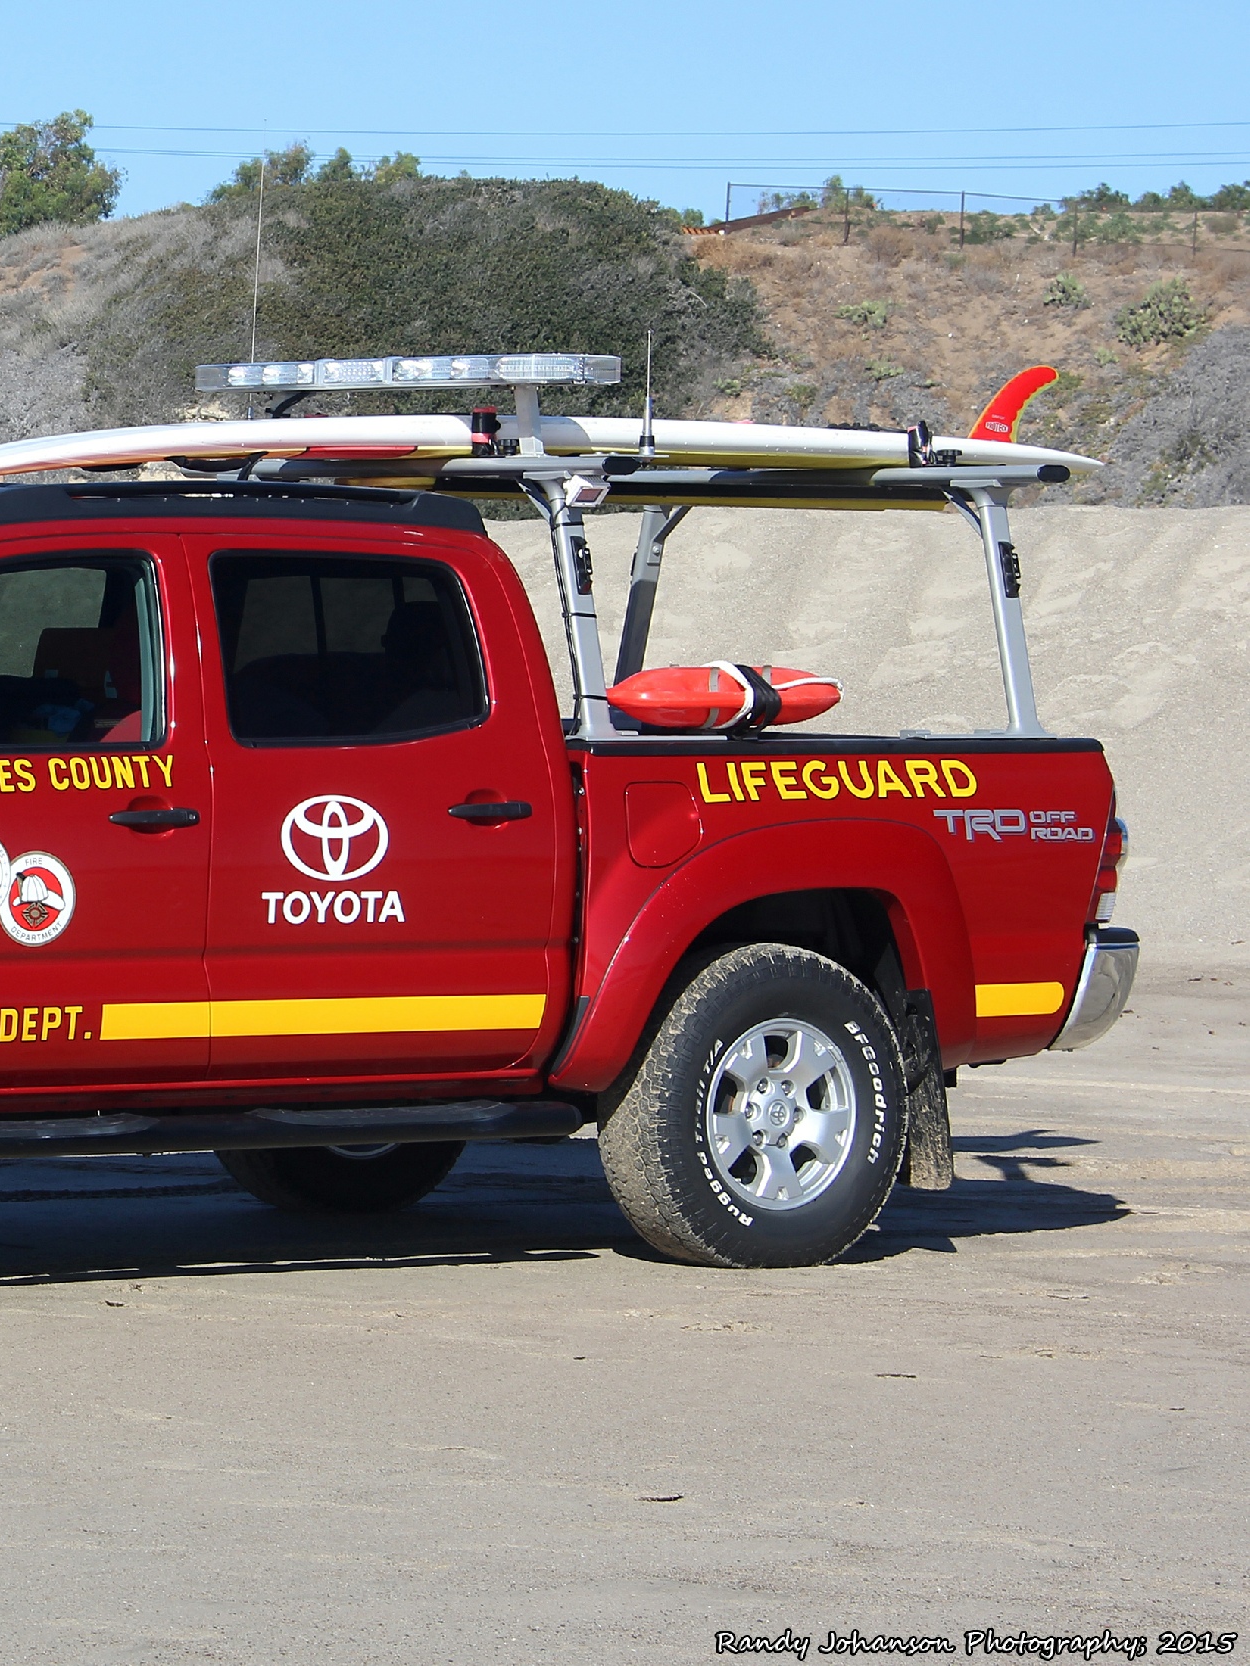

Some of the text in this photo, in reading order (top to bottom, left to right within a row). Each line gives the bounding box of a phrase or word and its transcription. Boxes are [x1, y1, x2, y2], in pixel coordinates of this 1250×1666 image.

[48, 754, 175, 792] COUNTY
[696, 759, 978, 803] LIFEGUARD
[933, 809, 1026, 842] TRD
[1029, 810, 1077, 825] OFF
[1030, 827, 1095, 843] ROAD
[25, 857, 43, 866] FIRE
[261, 890, 405, 924] TOYOTA
[10, 921, 62, 942] DEPARTMENT
[843, 1020, 888, 1164] BFGoodrich
[695, 1039, 754, 1227] Rugged Trail T/A
